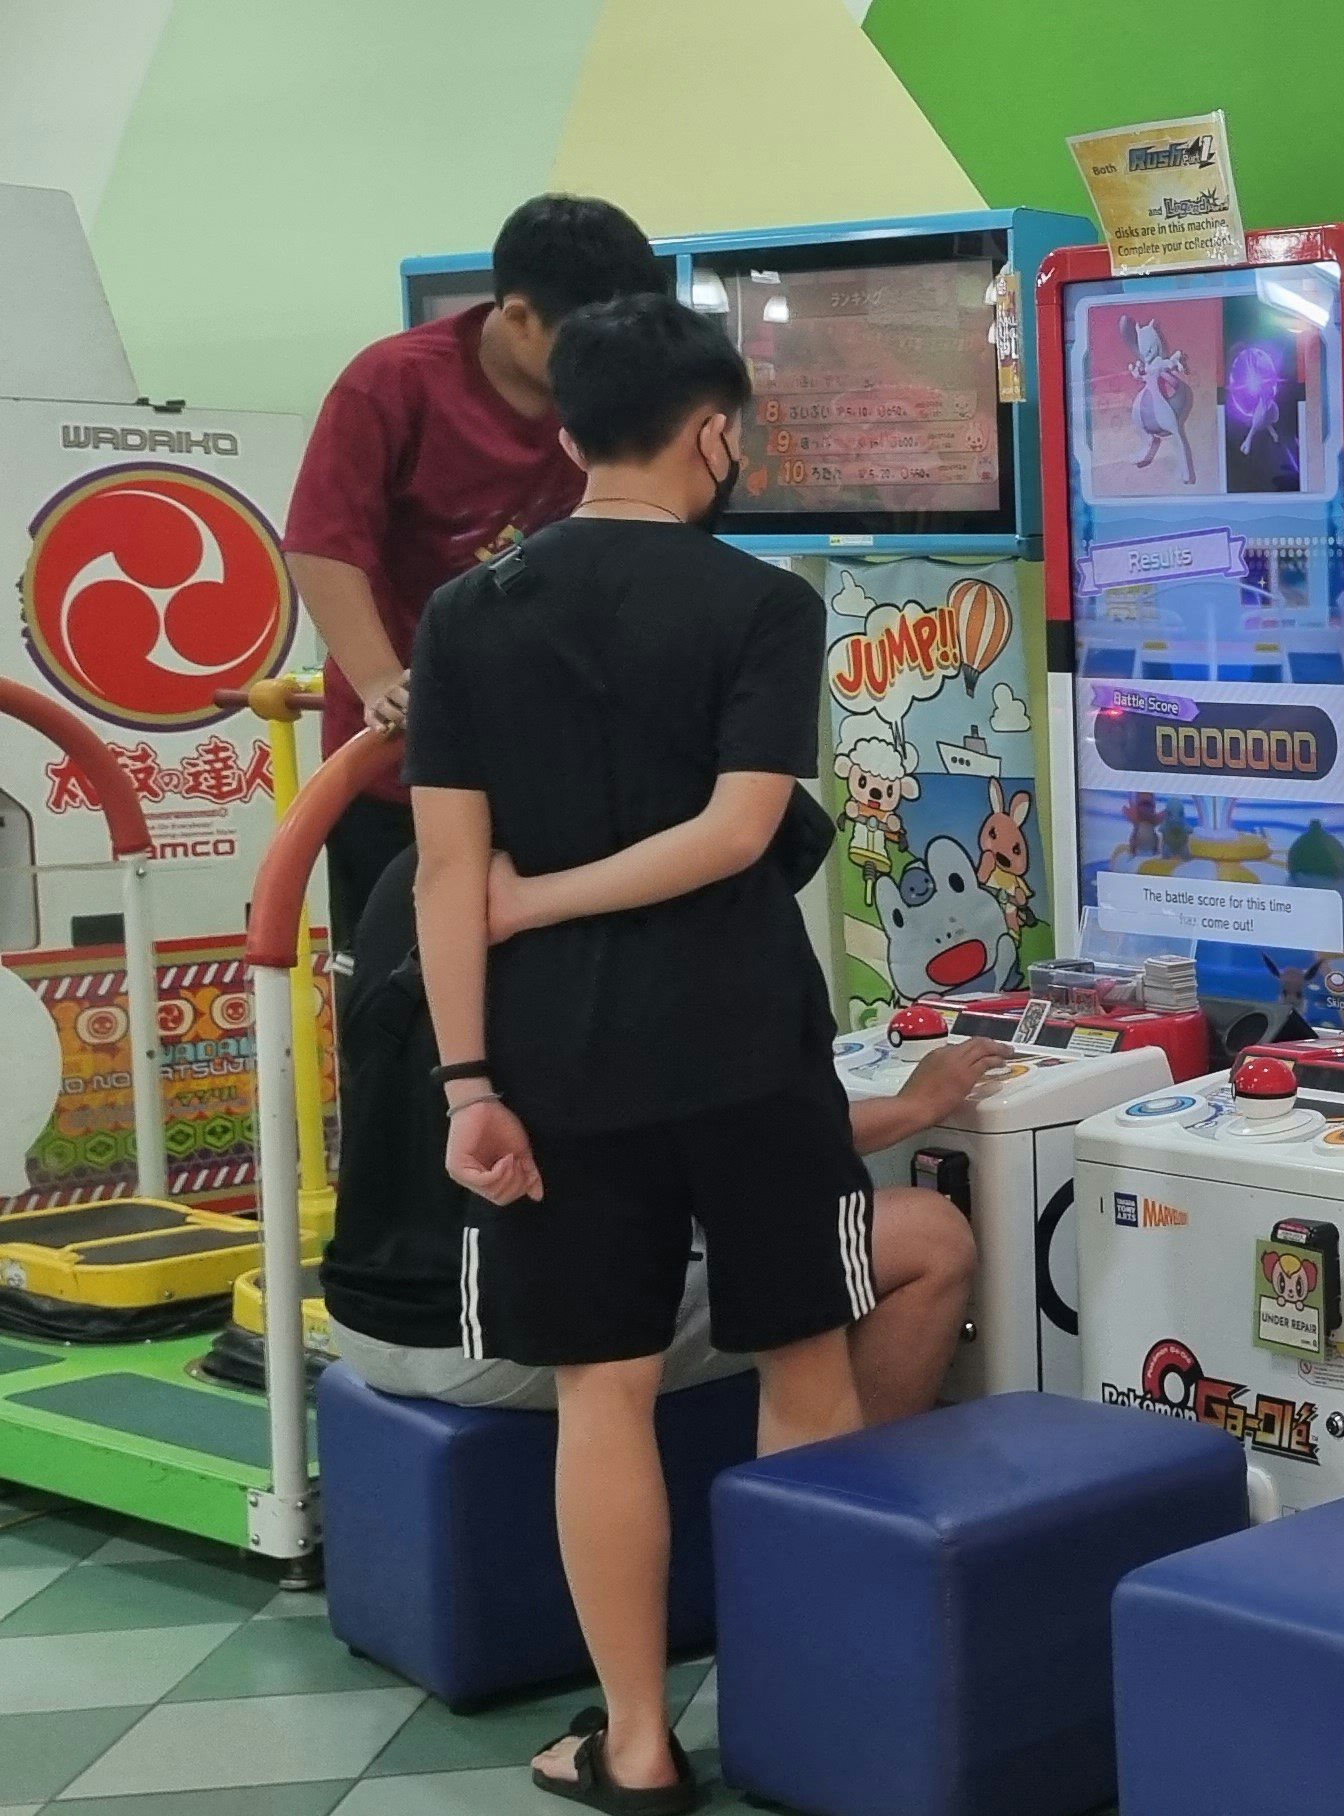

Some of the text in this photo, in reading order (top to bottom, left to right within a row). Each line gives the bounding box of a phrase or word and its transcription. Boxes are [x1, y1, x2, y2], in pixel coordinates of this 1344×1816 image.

[1092, 144, 1185, 176] Both Rush
[1149, 206, 1162, 216] and
[1115, 218, 1229, 239] disks are in this machine.
[1118, 242, 1182, 256] Complete your
[766, 400, 779, 422] 8
[61, 425, 239, 456] WADAIKO
[777, 430, 790, 452] 9
[784, 460, 805, 483] 10
[1127, 546, 1193, 573] Results
[833, 606, 960, 697] JUMP!!
[1113, 690, 1178, 714] Battle Score
[1156, 725, 1317, 773] 0000000
[1143, 888, 1292, 914] The battle score for this time
[1201, 917, 1254, 933] come out!
[1326, 997, 1344, 1010] Skip
[1262, 1312, 1316, 1334] UNDER REPAIR
